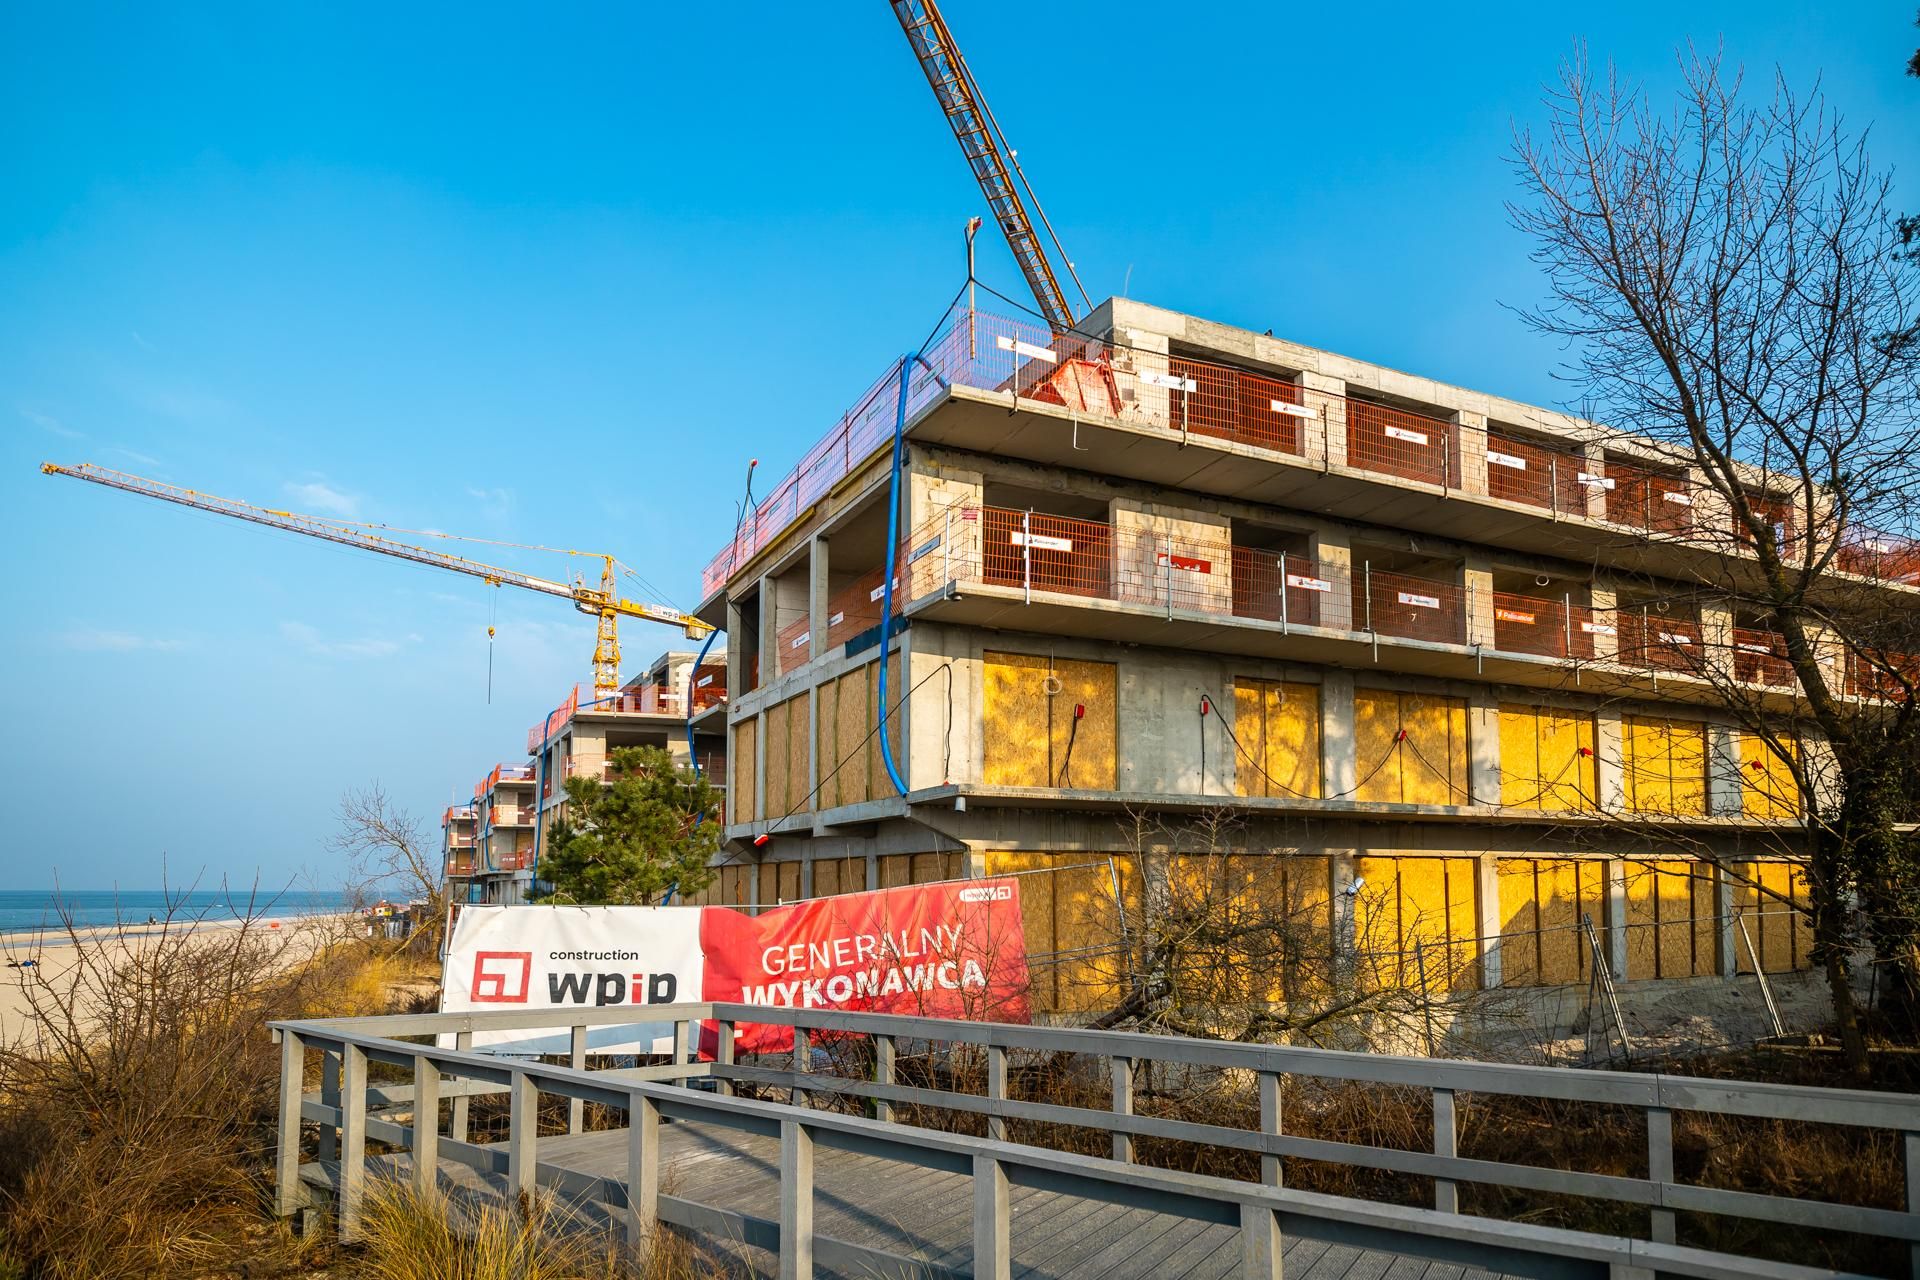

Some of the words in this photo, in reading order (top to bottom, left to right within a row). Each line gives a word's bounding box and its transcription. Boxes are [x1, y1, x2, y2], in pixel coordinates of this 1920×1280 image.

[550, 949, 639, 960] construction
[762, 924, 963, 975] GENERALNY
[548, 973, 677, 1006] wpip
[742, 960, 986, 1008] WYKONAWCA
